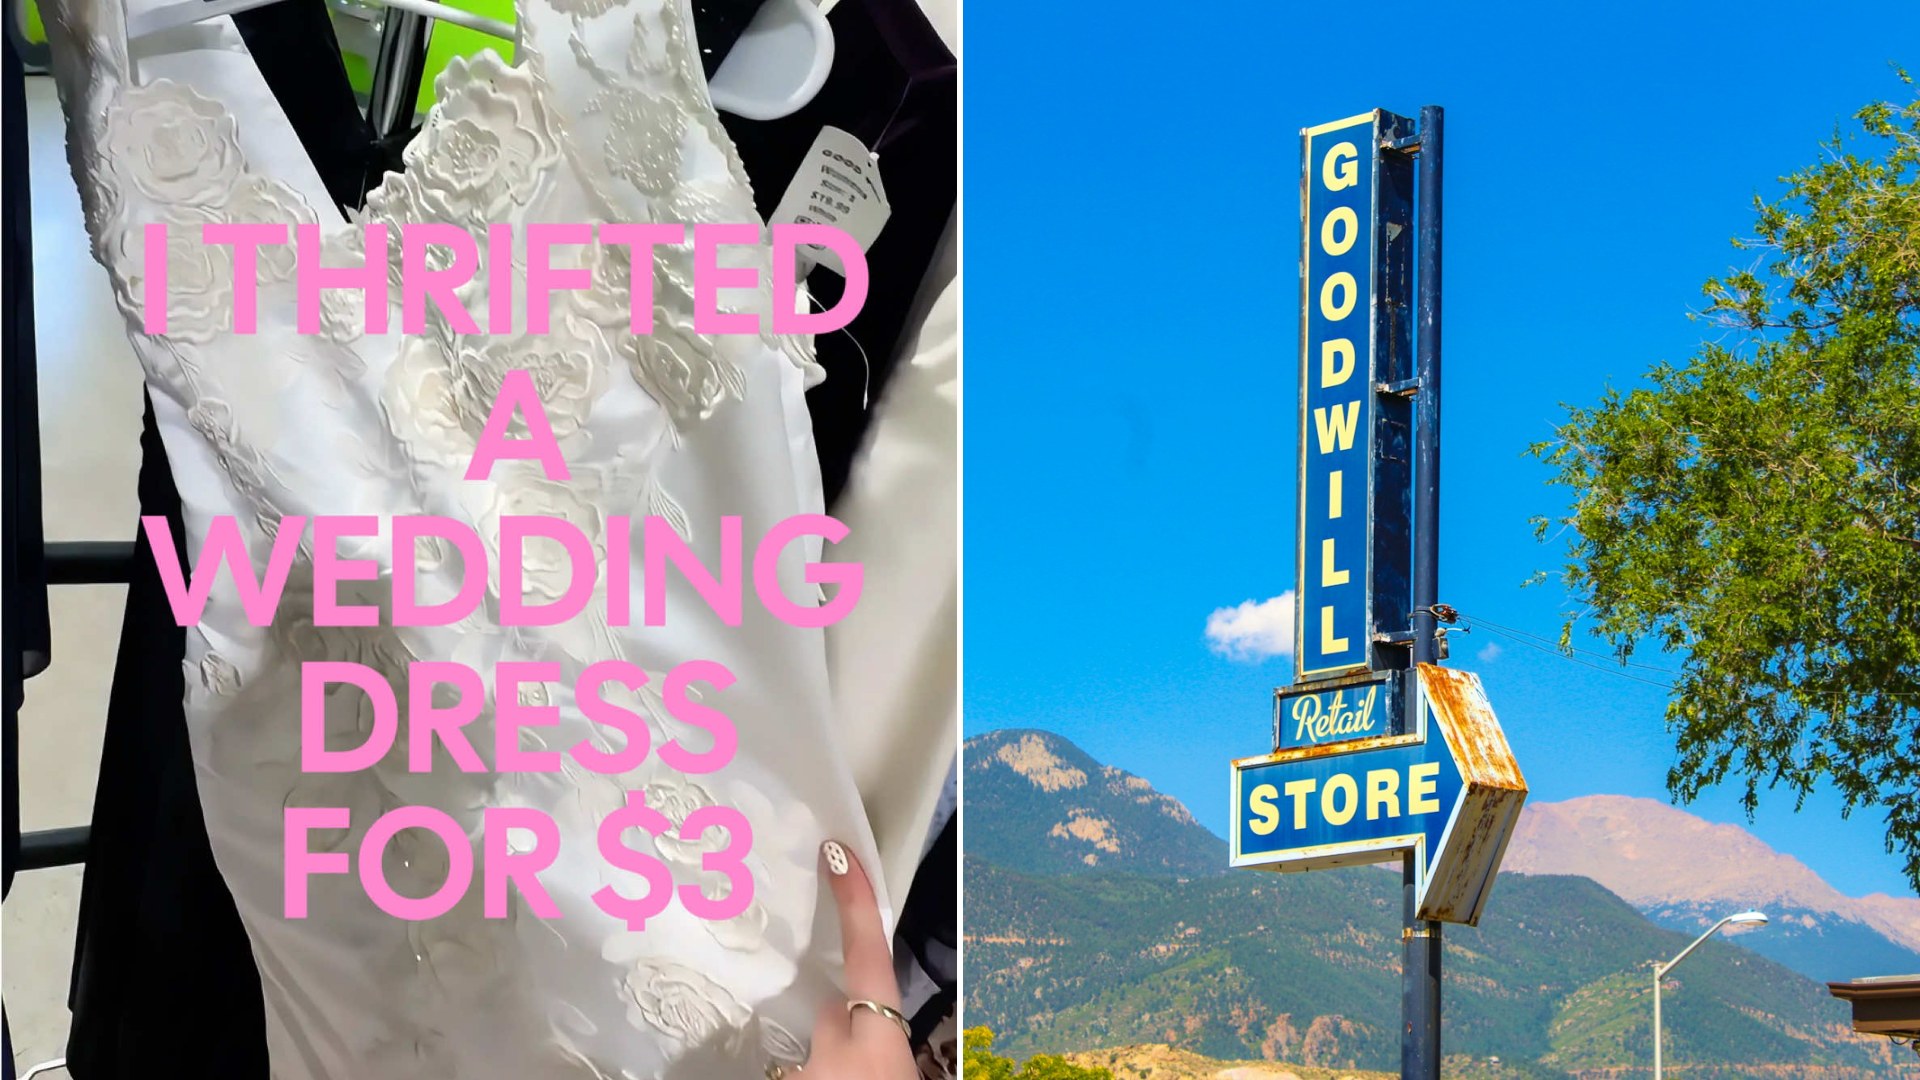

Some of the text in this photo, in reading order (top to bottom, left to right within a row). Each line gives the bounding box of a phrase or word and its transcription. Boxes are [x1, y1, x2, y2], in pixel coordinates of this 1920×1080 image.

[1314, 142, 1361, 655] GOODWILL
[1291, 684, 1377, 743] Retail
[1248, 761, 1440, 836] STORE
